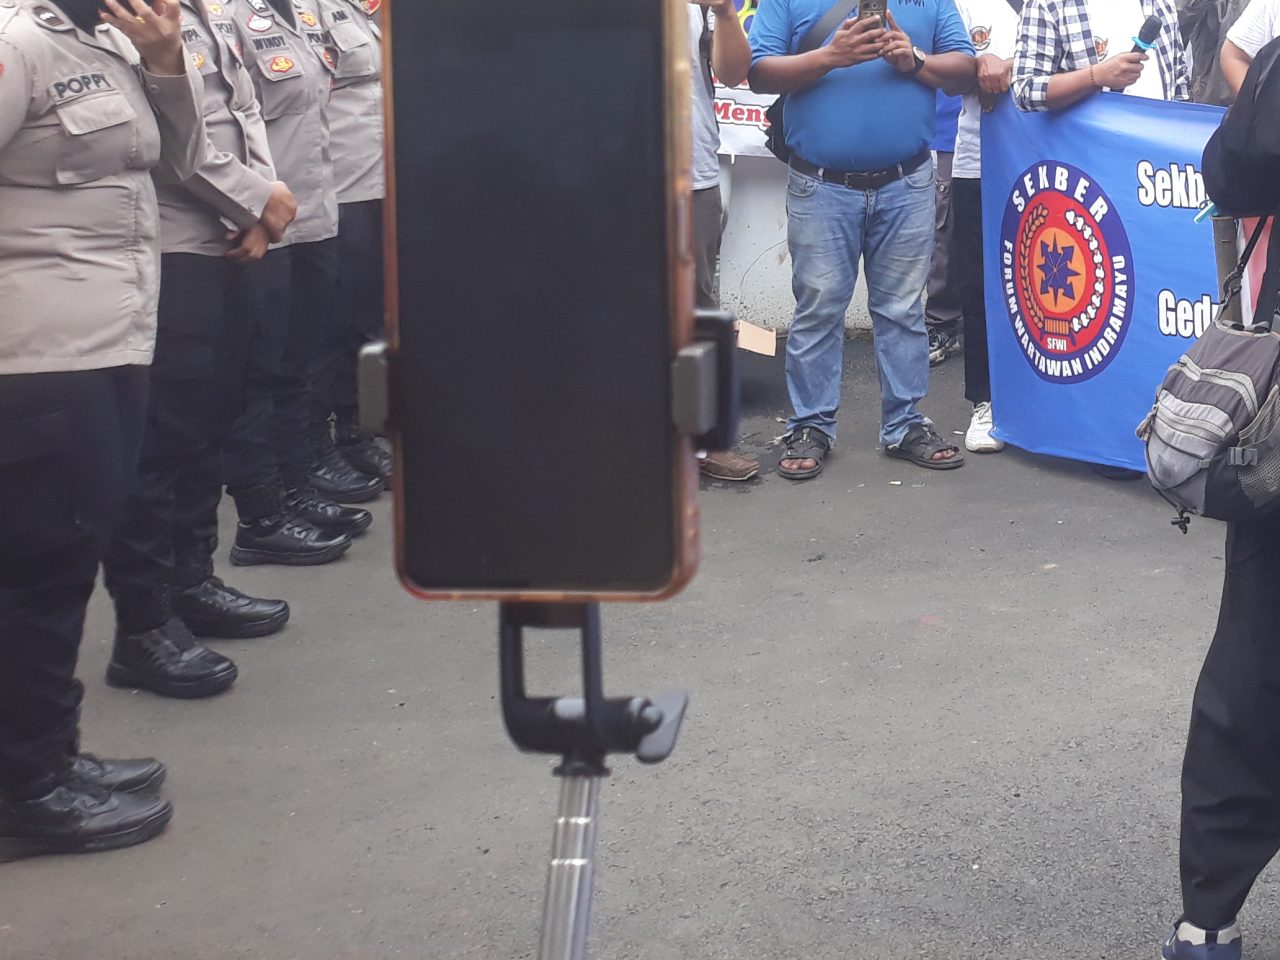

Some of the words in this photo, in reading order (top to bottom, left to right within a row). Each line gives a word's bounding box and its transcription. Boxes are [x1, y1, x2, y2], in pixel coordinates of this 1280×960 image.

[254, 36, 286, 51] WINDY
[1012, 164, 1109, 224] SEKBER
[1137, 159, 1210, 209] Sekb
[1003, 239, 1018, 315] FORUM
[1013, 314, 1084, 378] WARTAWAN
[1083, 254, 1129, 370] INDRAMAYU
[1158, 288, 1219, 339] Ged
[1046, 337, 1068, 352] SFWI
